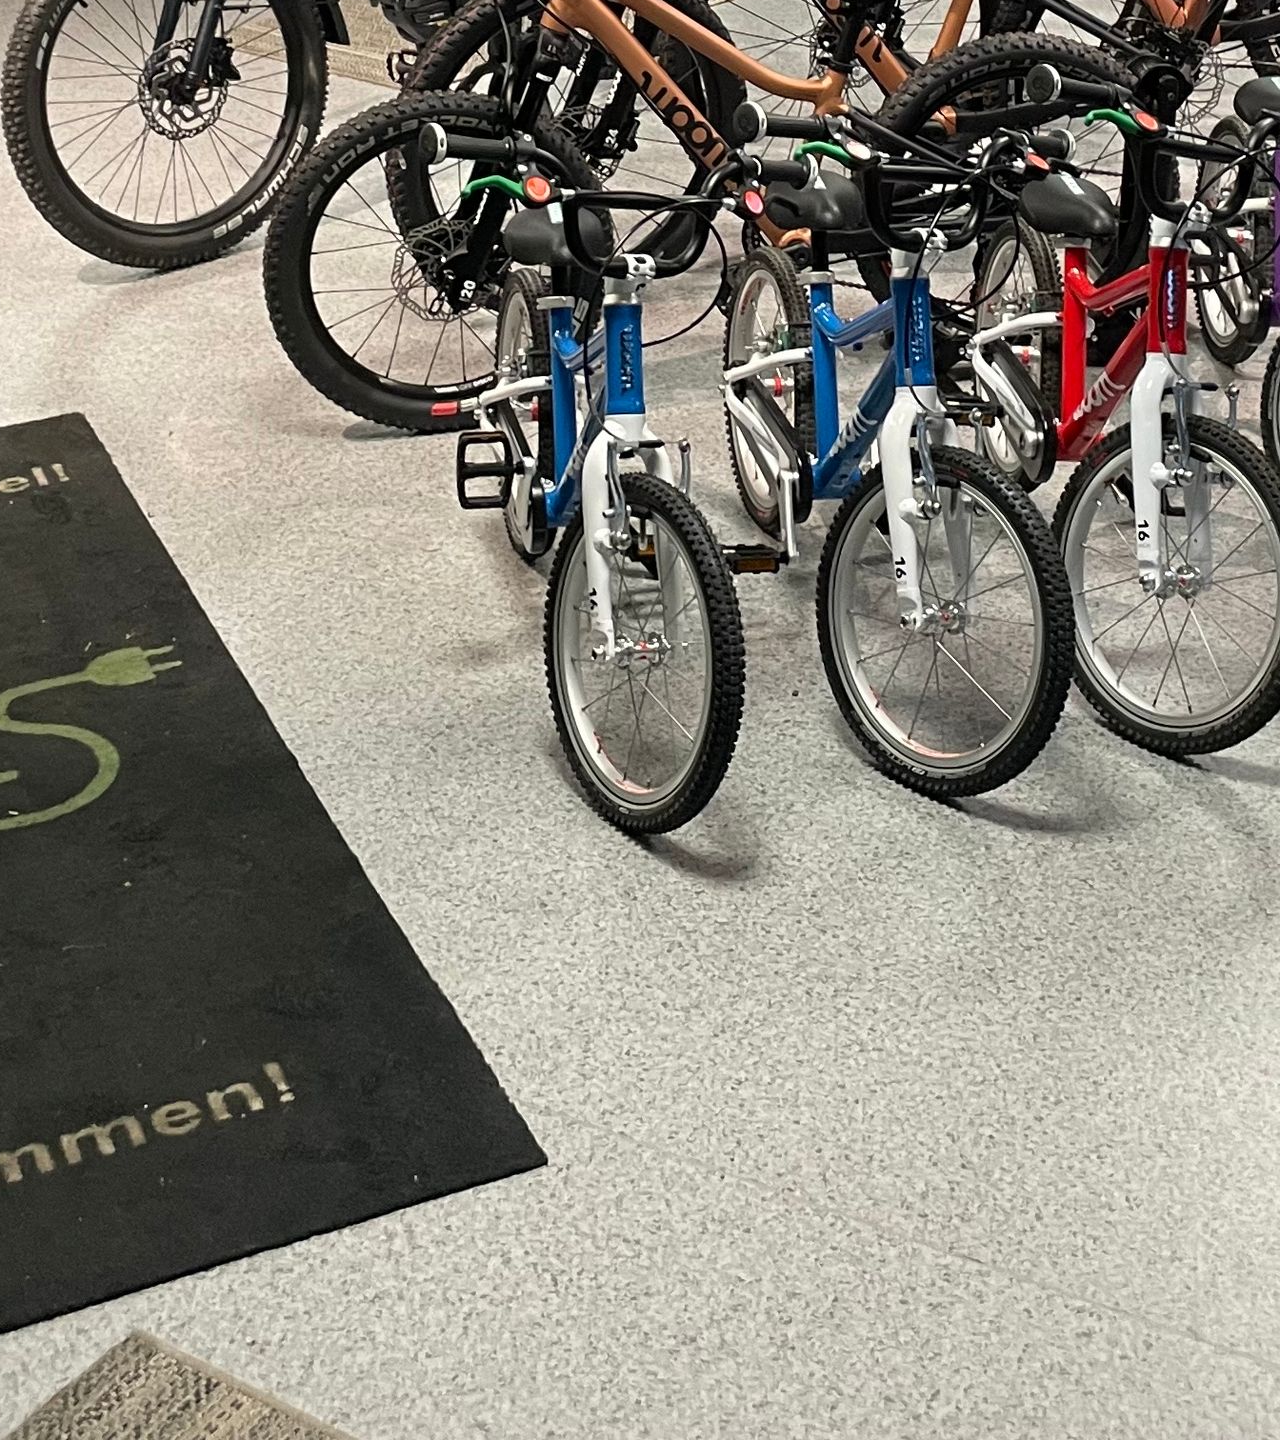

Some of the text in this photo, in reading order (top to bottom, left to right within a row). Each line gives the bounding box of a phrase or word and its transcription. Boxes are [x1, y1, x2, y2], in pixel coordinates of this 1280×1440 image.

[212, 123, 309, 240] SCHWALBE
[1137, 519, 1150, 542] 16
[894, 556, 907, 579] 16
